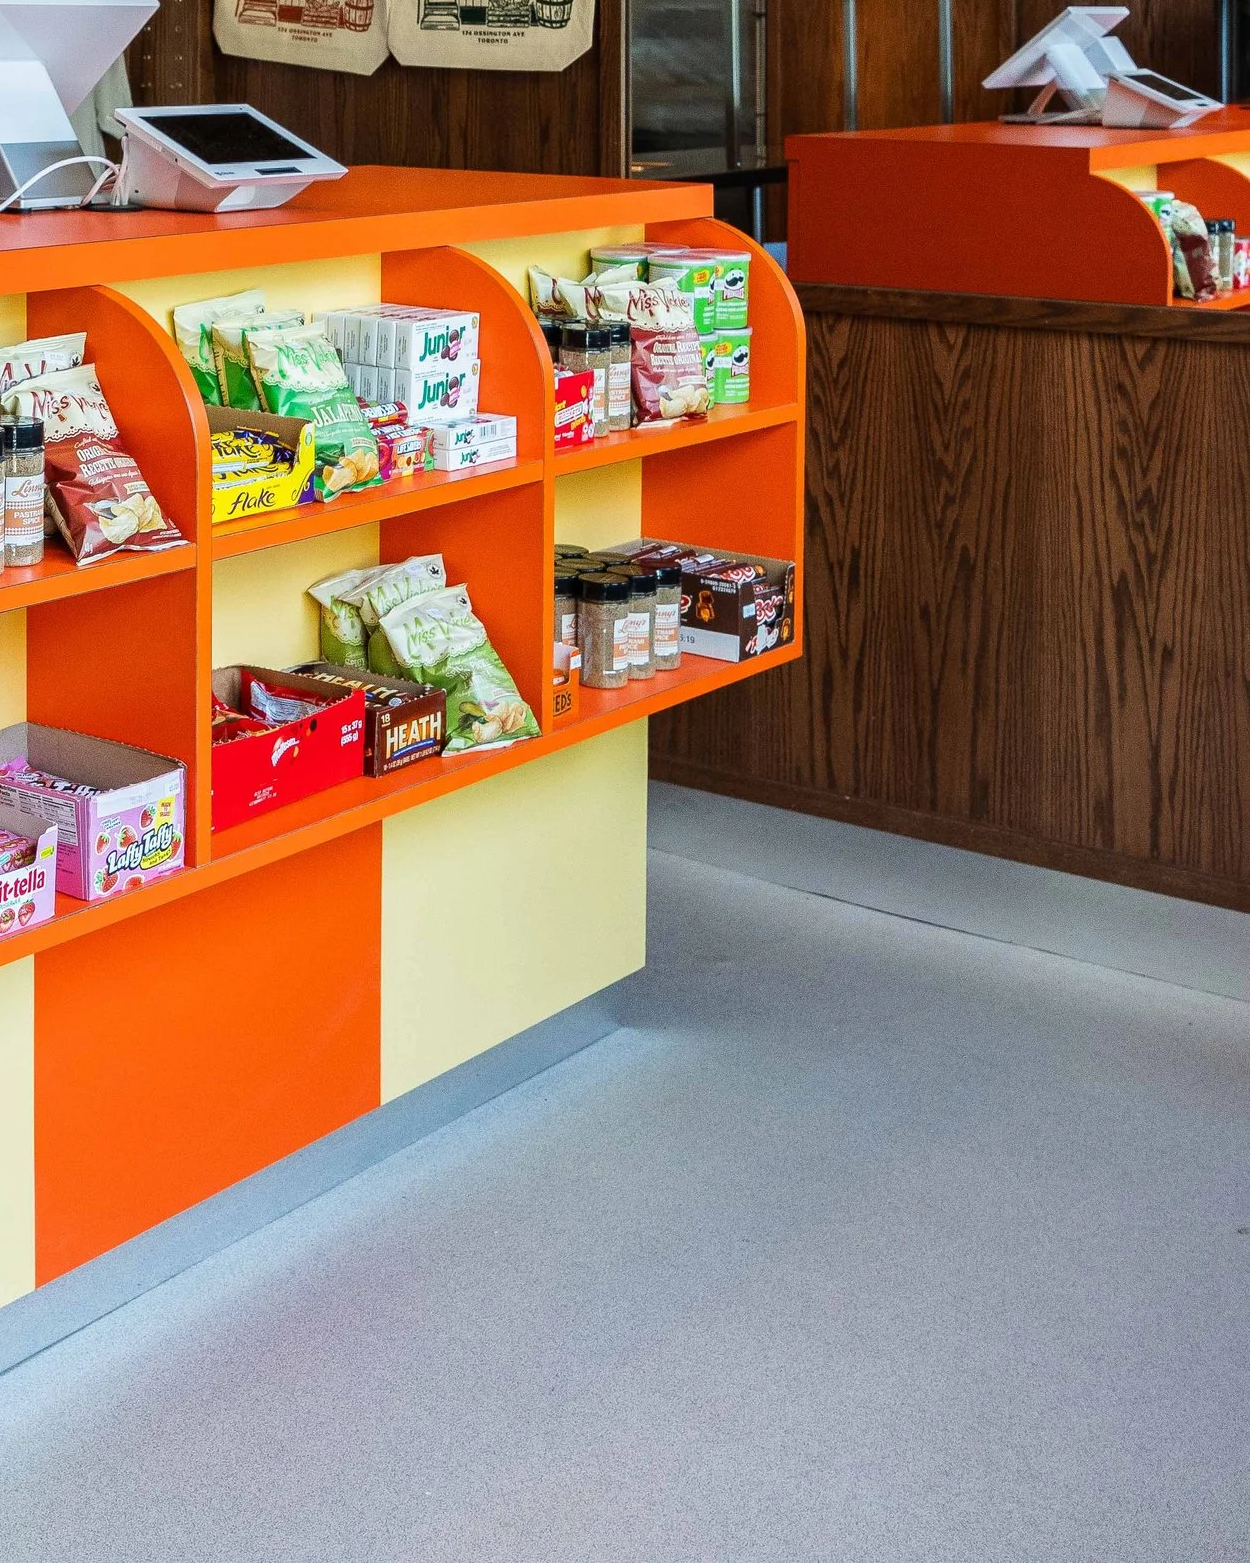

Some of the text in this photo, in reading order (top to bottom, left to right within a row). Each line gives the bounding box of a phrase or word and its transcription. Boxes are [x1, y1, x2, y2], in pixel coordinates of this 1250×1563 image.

[419, 325, 466, 363] Junior
[418, 372, 466, 410] Junior
[227, 487, 276, 515] flake
[380, 714, 391, 725] 18
[385, 711, 442, 760] HEATH
[106, 822, 175, 875] Laffy Taffy
